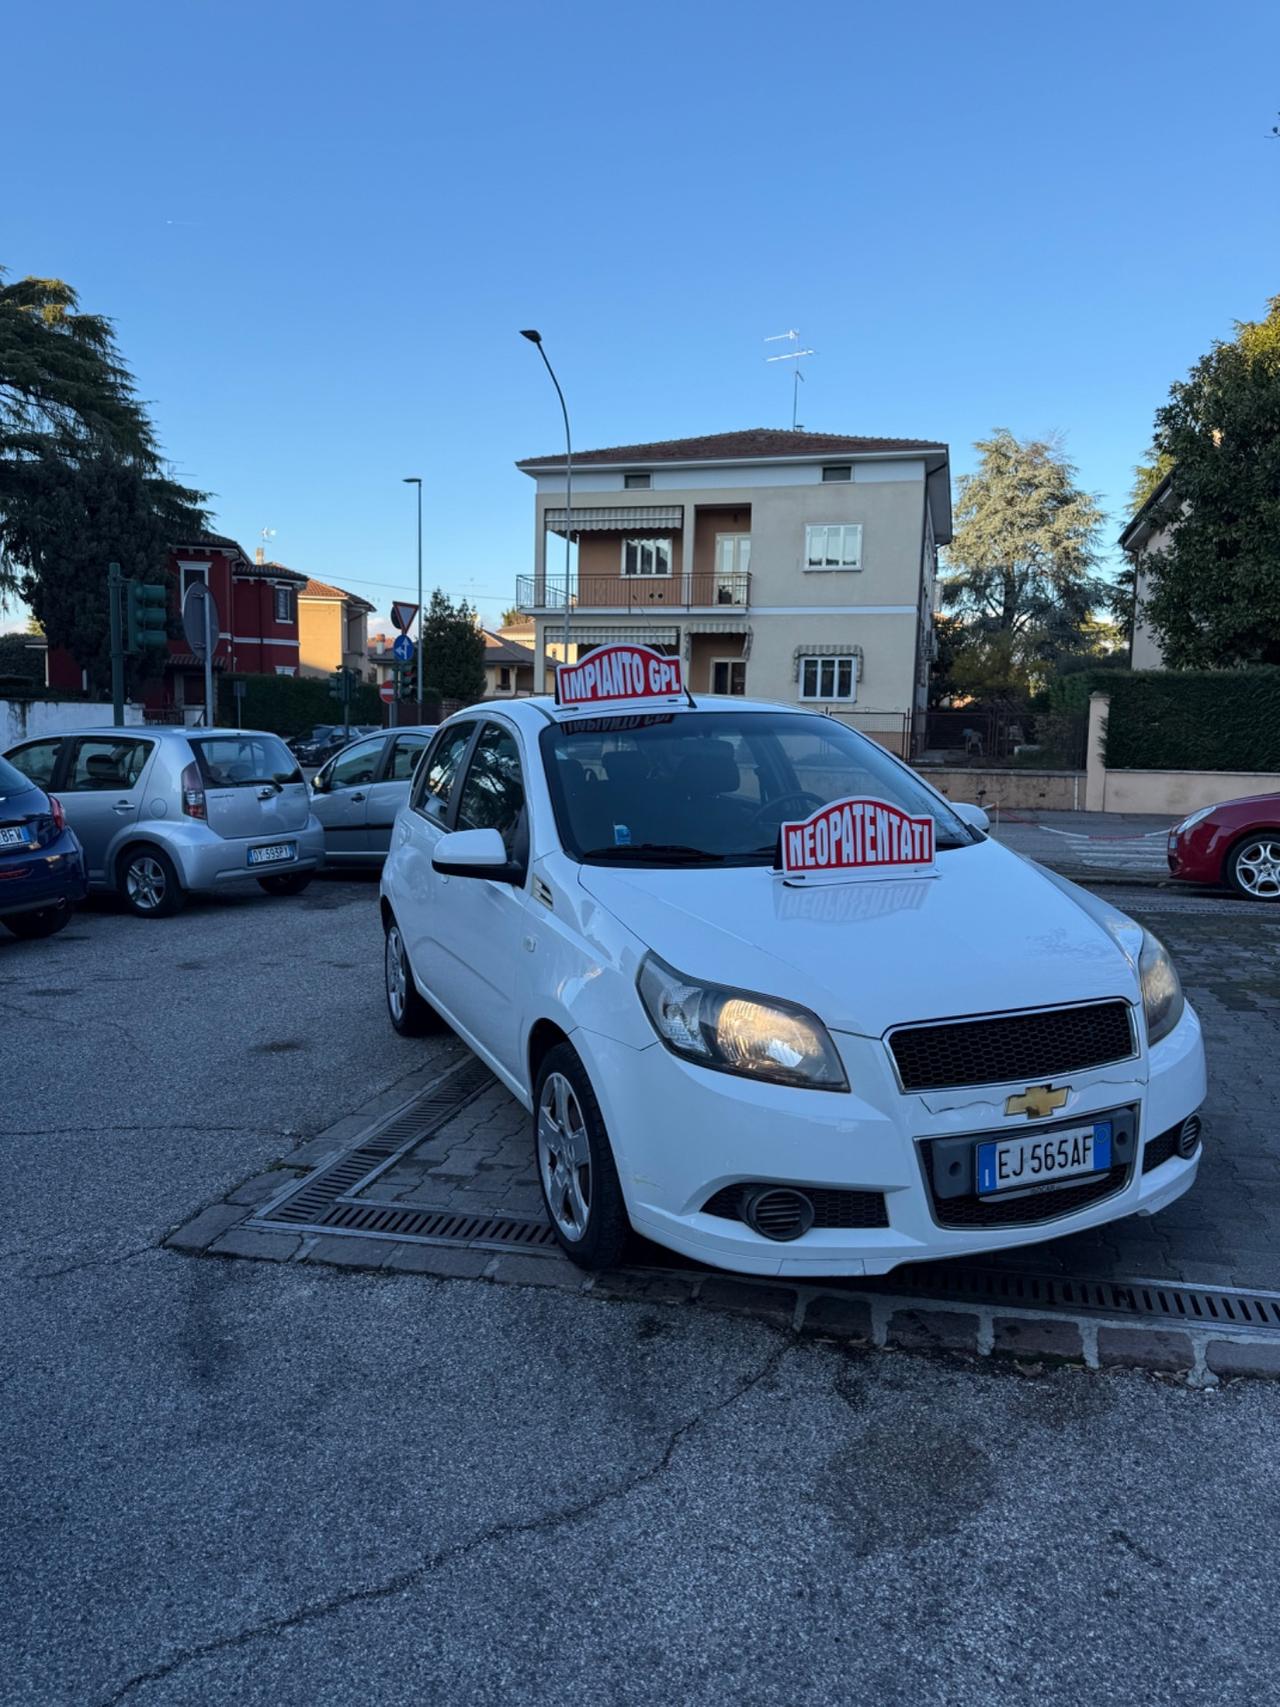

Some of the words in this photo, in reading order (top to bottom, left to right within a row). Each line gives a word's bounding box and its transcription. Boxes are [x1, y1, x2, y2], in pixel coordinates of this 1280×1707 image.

[563, 651, 645, 700] IMPIANTO
[648, 659, 680, 693] GPL
[0, 828, 22, 843] 8FW
[788, 803, 929, 867] NEOPATENTATI
[998, 1146, 1024, 1180] EJ
[1030, 1135, 1093, 1174] 565AF
